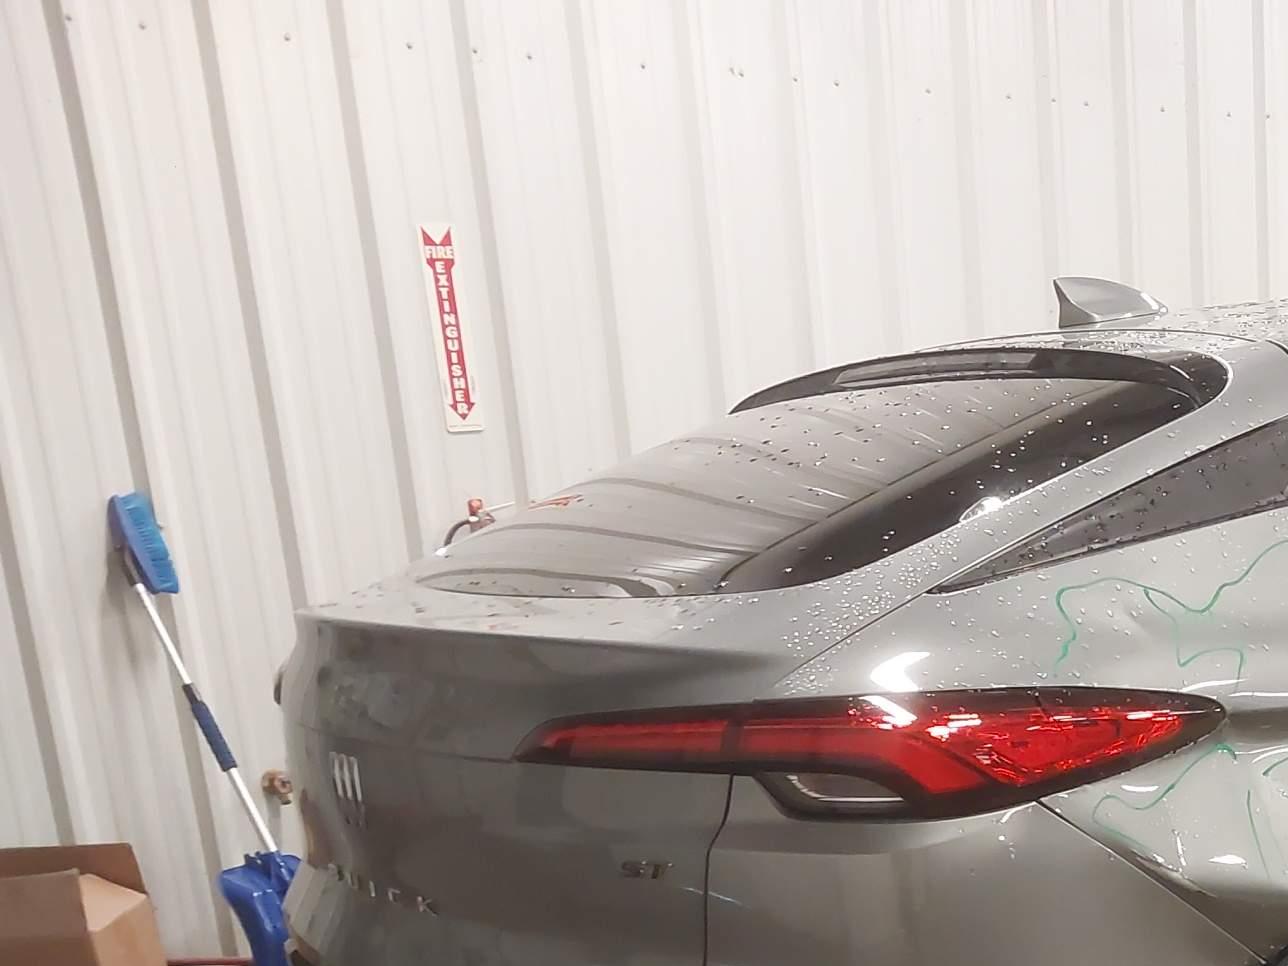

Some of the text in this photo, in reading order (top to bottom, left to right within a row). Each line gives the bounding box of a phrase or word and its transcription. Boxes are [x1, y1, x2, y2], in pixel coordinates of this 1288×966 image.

[424, 245, 454, 259] FIRE
[434, 261, 469, 415] EXTINGUISHER
[621, 861, 673, 880] ST
